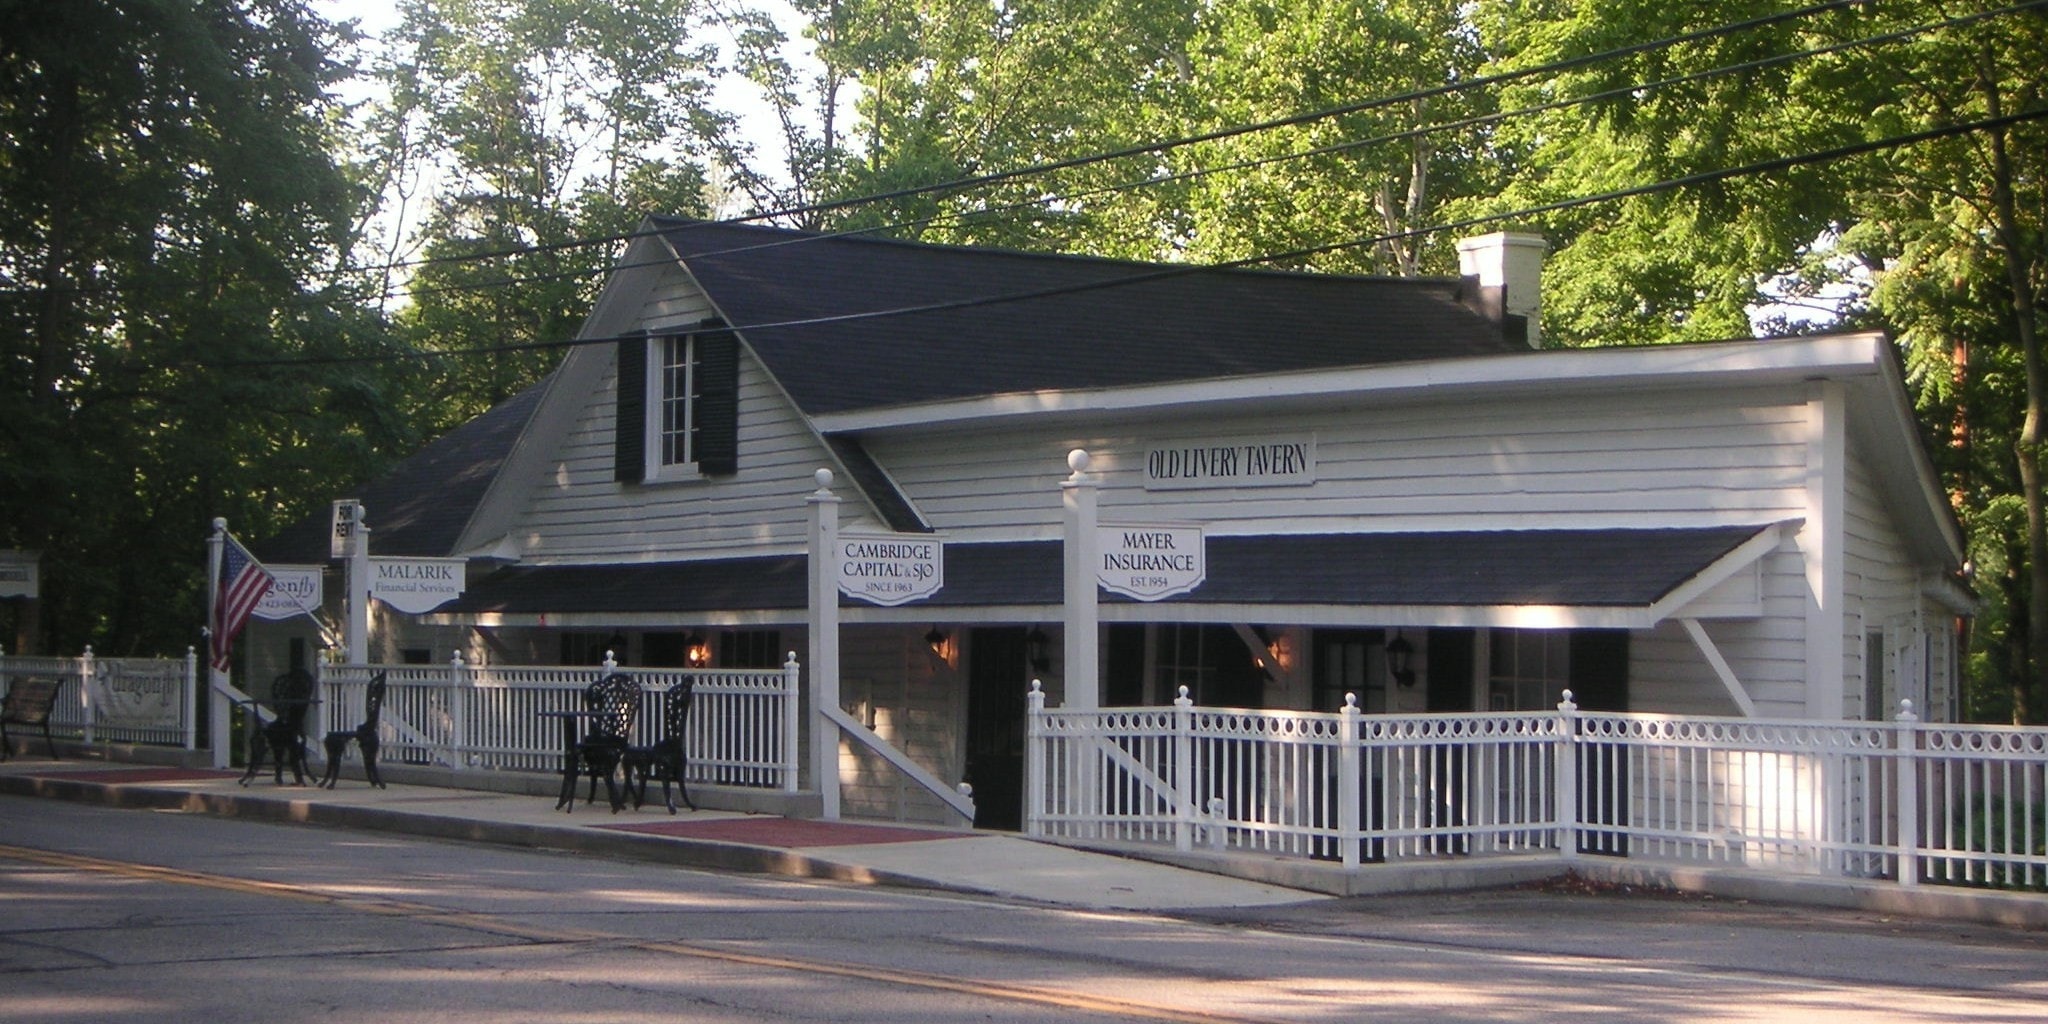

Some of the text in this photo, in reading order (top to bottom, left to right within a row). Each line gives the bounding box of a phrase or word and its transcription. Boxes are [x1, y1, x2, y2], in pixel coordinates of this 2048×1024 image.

[1149, 443, 1308, 480] OLD LIVERY TAVERN
[338, 504, 353, 520] FOR
[335, 522, 355, 537] RENT
[1123, 532, 1176, 550] MAYER
[845, 543, 932, 560] CAMBRIDGE
[1104, 553, 1195, 571] INSURANCE
[378, 564, 453, 580] MALARIK
[375, 581, 457, 593] Financial Services
[865, 582, 914, 593] SINCE 1963
